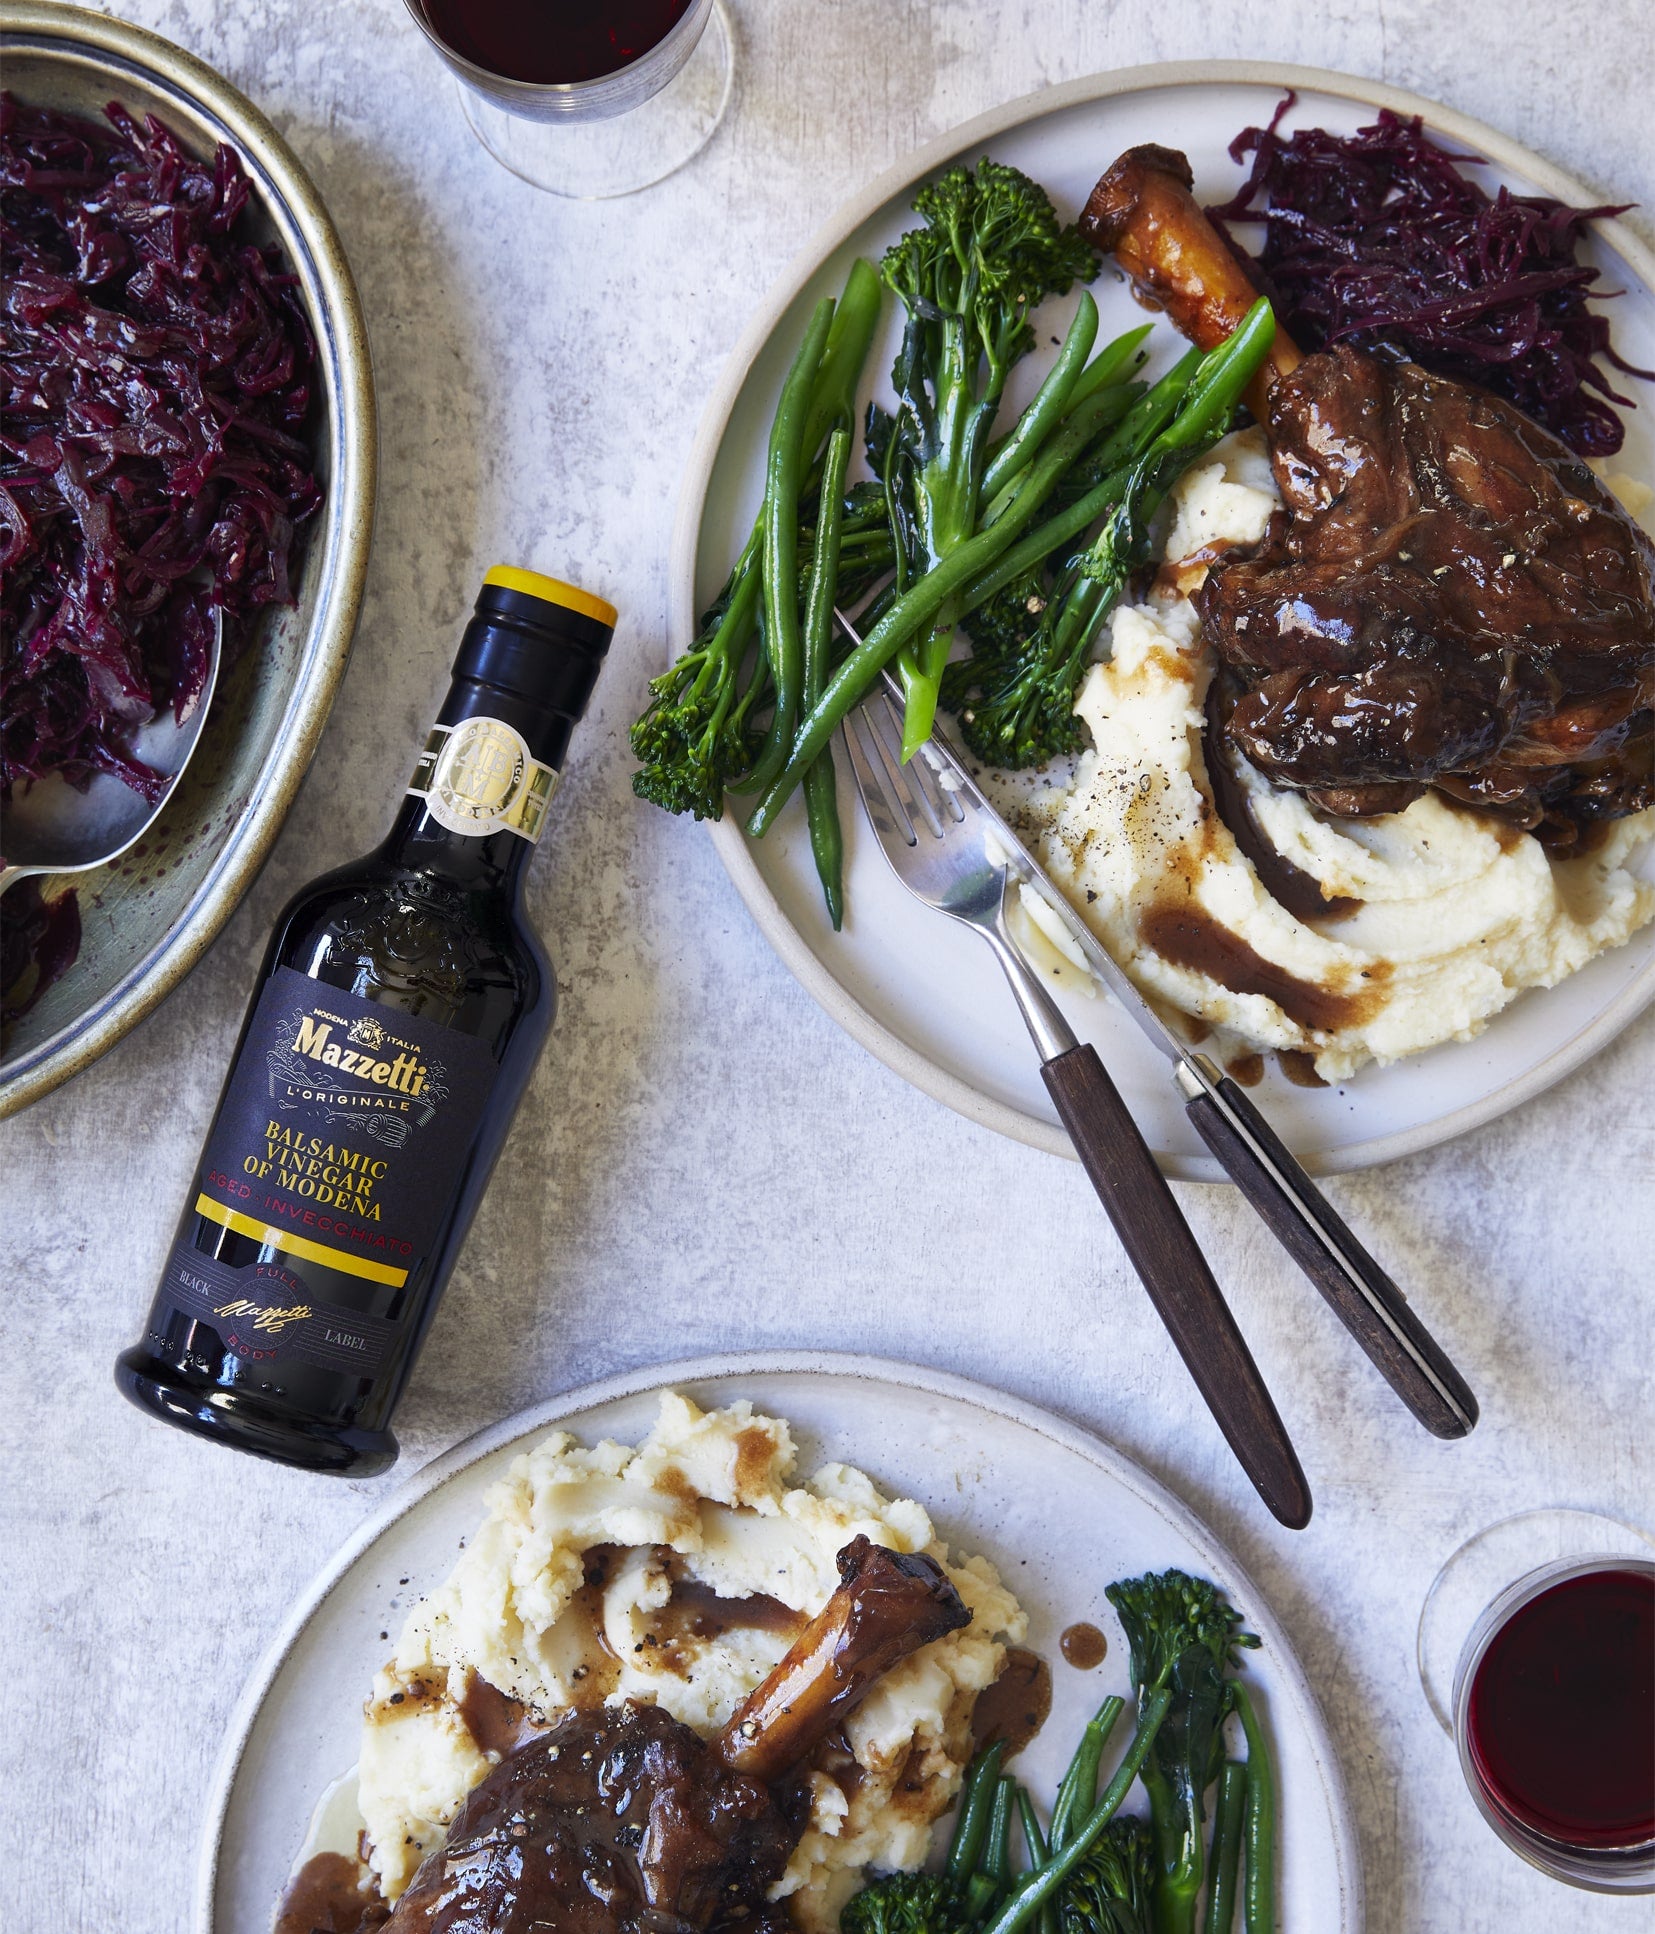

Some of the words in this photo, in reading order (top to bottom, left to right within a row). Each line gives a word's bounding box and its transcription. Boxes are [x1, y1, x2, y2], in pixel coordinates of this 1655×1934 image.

[313, 1008, 349, 1027] MODENA
[292, 1016, 427, 1097] Mazzetti
[387, 1035, 421, 1052] ITALIA
[287, 1086, 410, 1111] L'ORIGINALE
[264, 1120, 388, 1179] BALSAMIC
[266, 1142, 372, 1197] VINEGAR
[243, 1155, 272, 1179] OF
[275, 1168, 382, 1221] MODENA
[208, 1170, 250, 1199] AGED
[265, 1198, 413, 1255] INVECCHIATO
[179, 1269, 210, 1296] BLACK
[255, 1267, 297, 1289] FULL
[228, 1334, 278, 1360] BODY
[323, 1329, 367, 1351] LABEL
